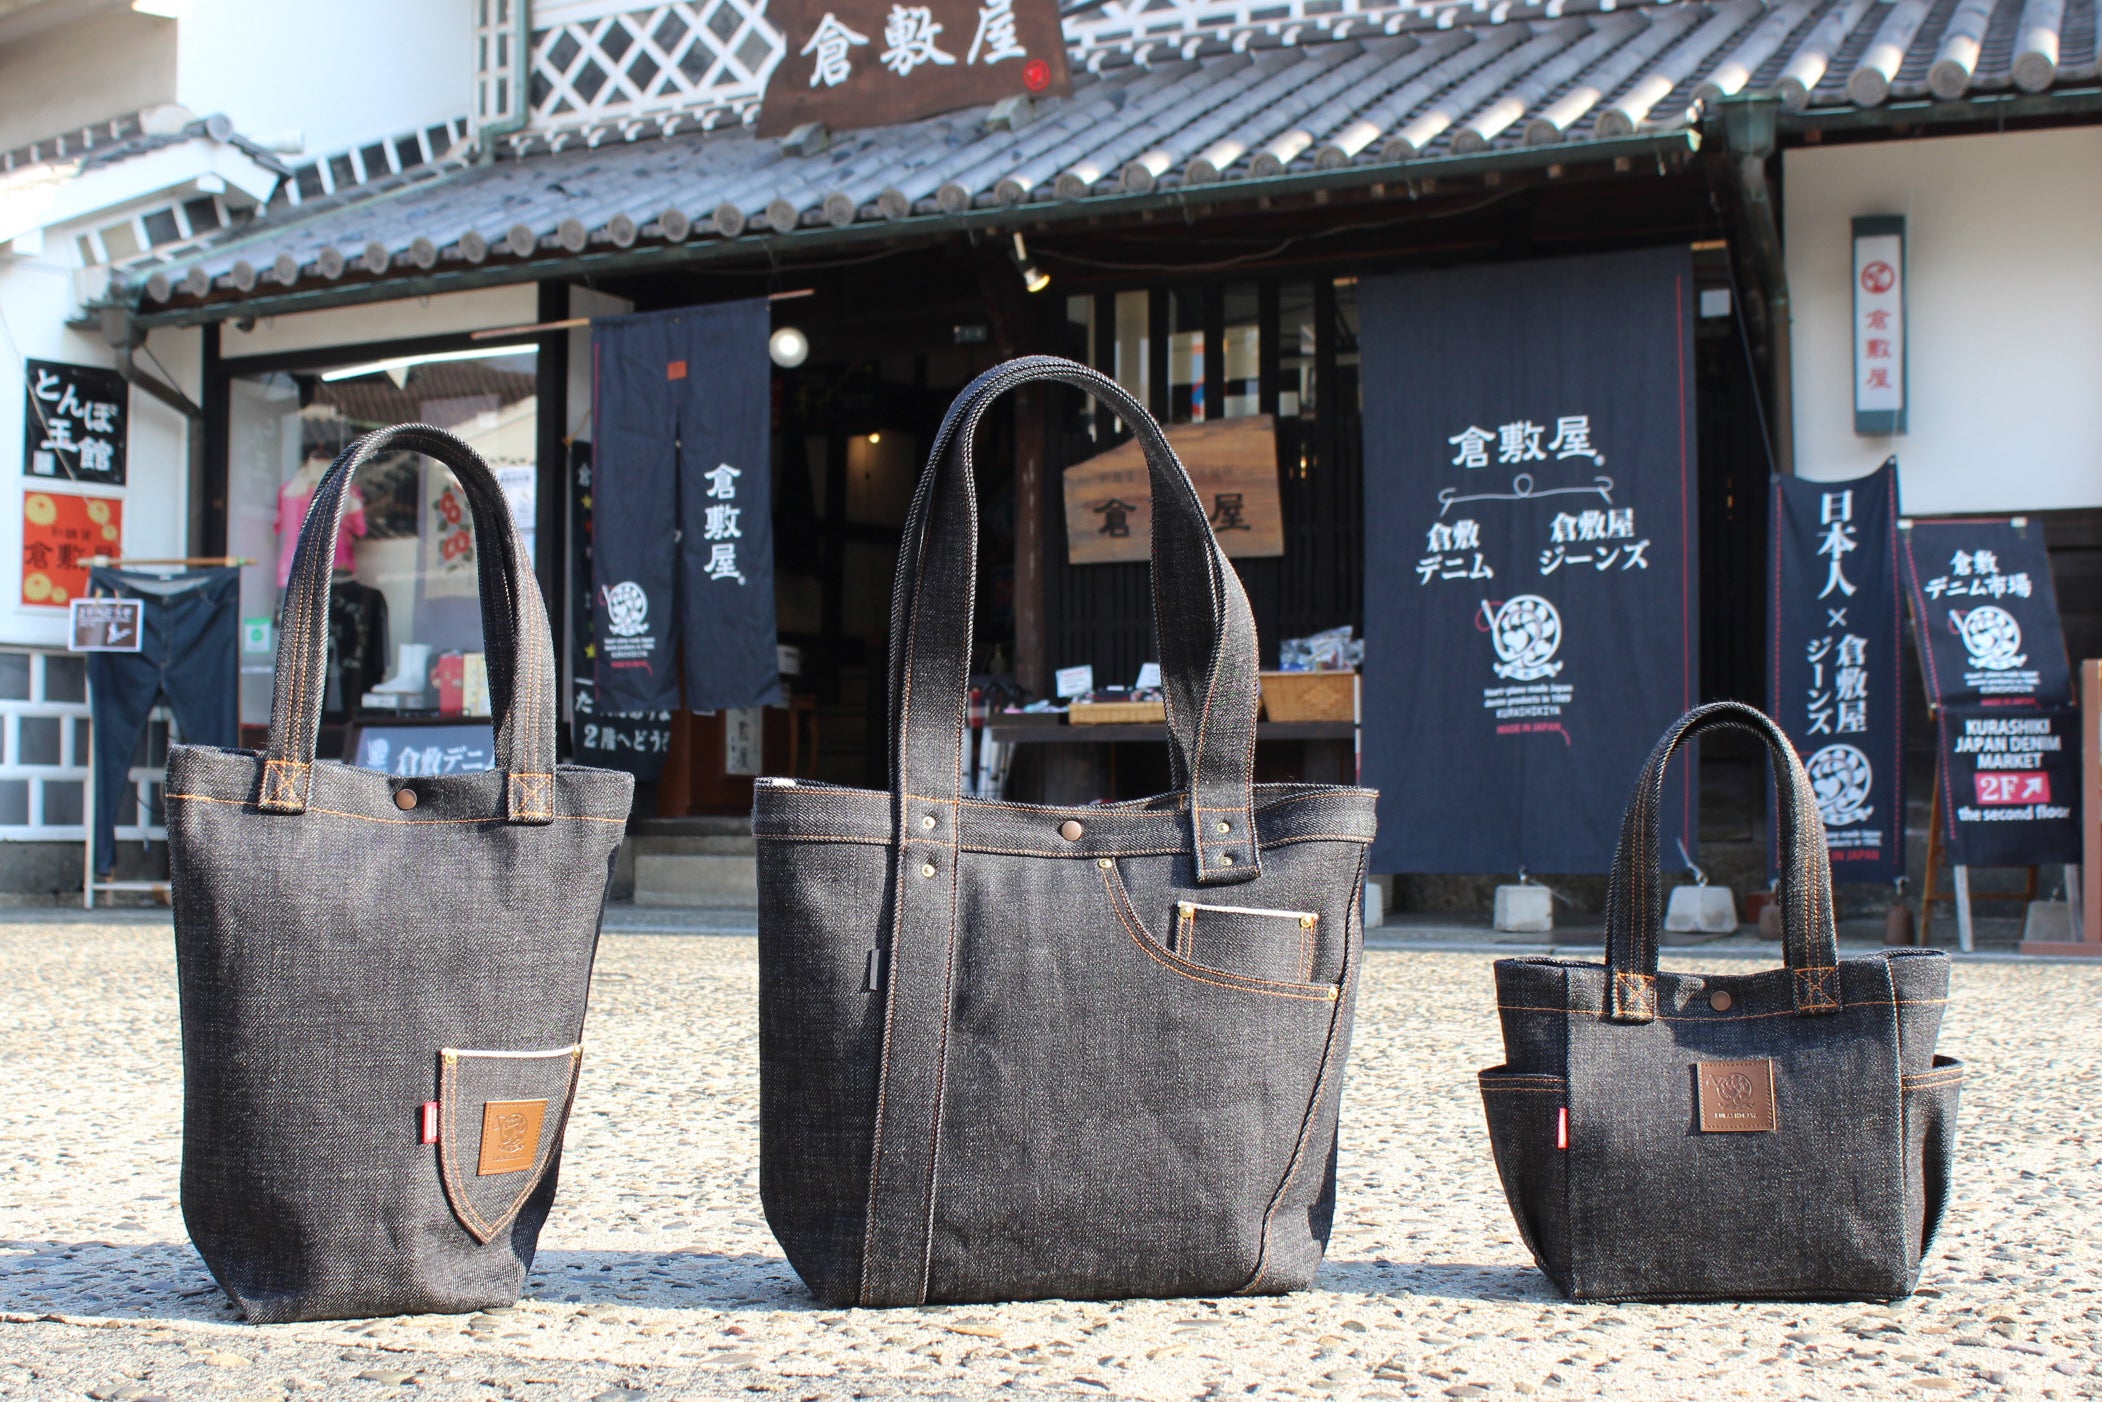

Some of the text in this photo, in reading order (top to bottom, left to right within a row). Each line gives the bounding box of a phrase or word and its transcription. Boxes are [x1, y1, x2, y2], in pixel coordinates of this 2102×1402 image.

[800, 0, 1027, 88] 倉敷屋
[35, 368, 119, 434] とんぼ
[1092, 496, 1250, 538] 倉屋
[1549, 507, 1637, 543] 倉敷屋
[1426, 519, 1480, 553] 倉敷
[1816, 488, 1859, 600] 日本人
[1415, 553, 1495, 586] デニム
[1538, 539, 1651, 576] ジーンズ
[1951, 549, 1998, 577] 倉敷
[1923, 572, 2033, 600] デニム市場
[1805, 635, 1833, 736] ジーンズ
[1835, 633, 1869, 734] 倉敷屋
[1954, 735, 2062, 752] JAPAN DENIM
[1965, 718, 2051, 736] KURASHIKI
[1976, 752, 2044, 769] MARKET
[1979, 775, 2019, 801] 2F
[1957, 803, 2071, 821] the second floor
